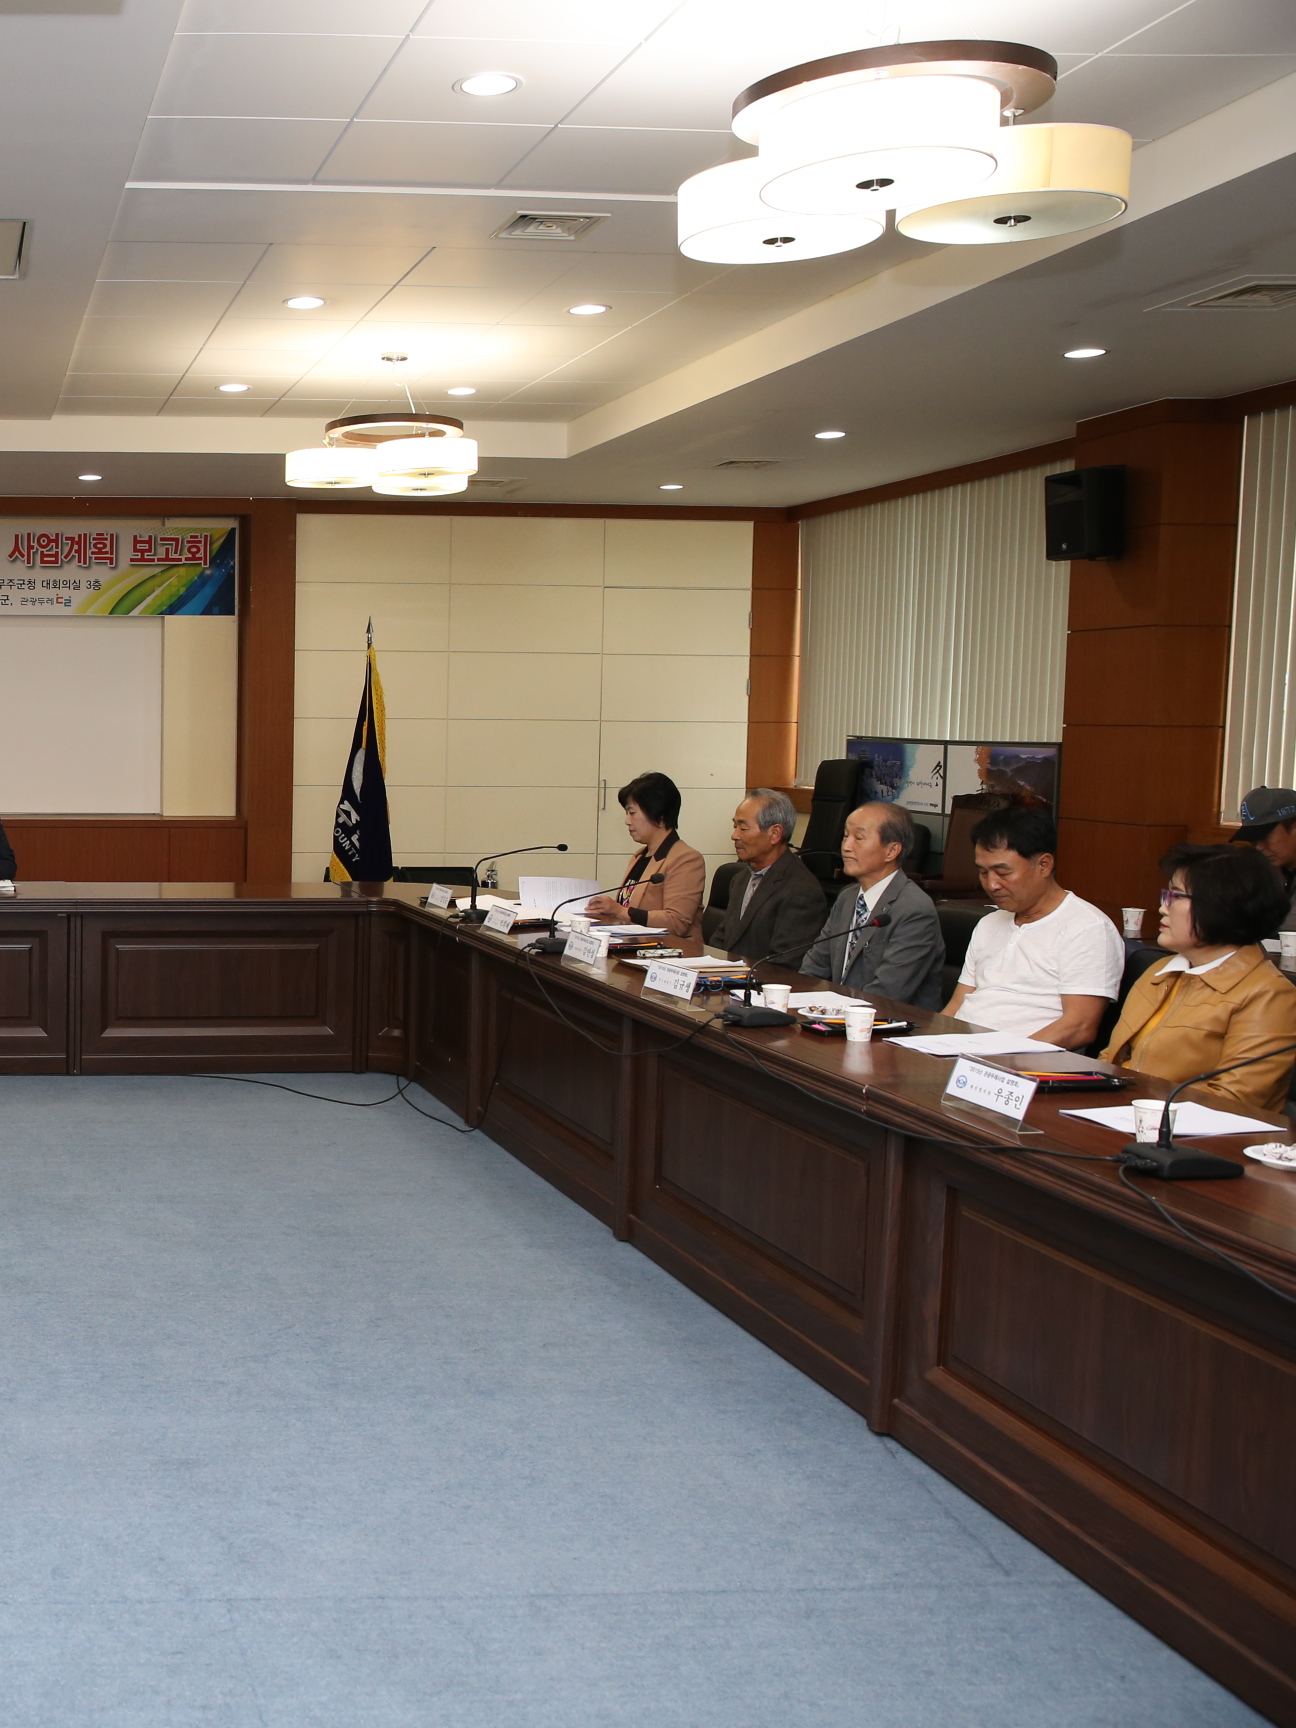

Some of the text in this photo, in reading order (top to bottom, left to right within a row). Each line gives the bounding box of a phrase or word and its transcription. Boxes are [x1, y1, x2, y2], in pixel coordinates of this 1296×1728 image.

[8, 531, 117, 567] 사업계획
[129, 533, 211, 567] 보고회
[41, 578, 81, 590] 대회의실
[86, 579, 102, 590] 3층
[20, 597, 54, 606] 관광두레
[334, 828, 360, 862] OUNTY
[994, 1088, 1024, 1110] 우종인
